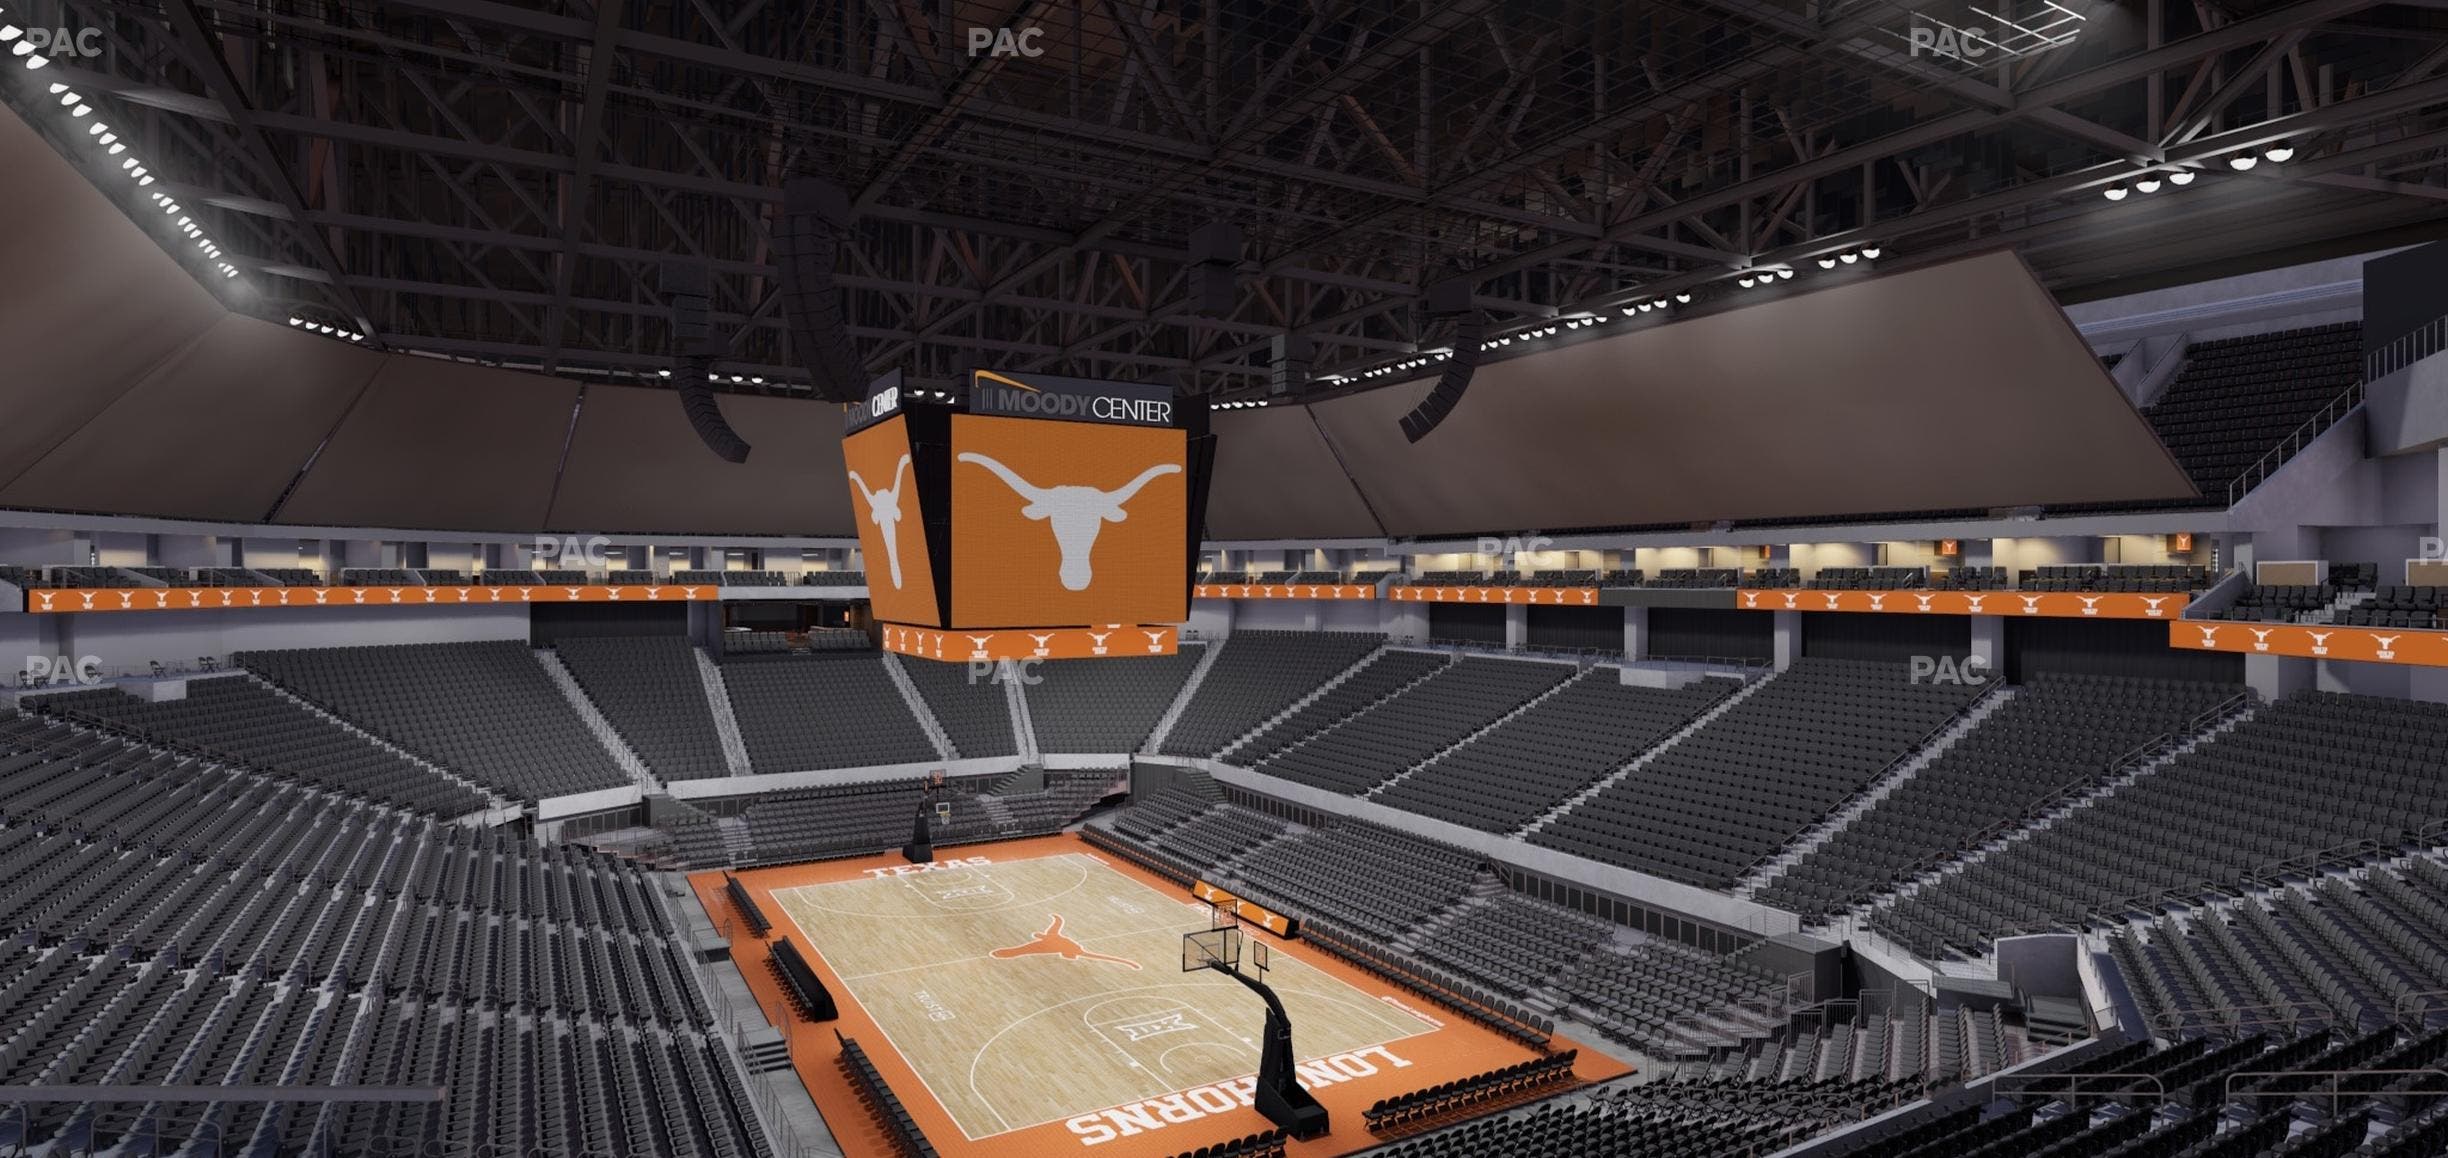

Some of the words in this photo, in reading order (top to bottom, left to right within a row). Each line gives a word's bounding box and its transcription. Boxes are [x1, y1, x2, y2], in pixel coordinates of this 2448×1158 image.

[998, 388, 1091, 416] MOODY
[1092, 396, 1171, 423] CENTER
[863, 856, 992, 880] TEXAS
[1065, 1045, 1413, 1146] LONHORNS
